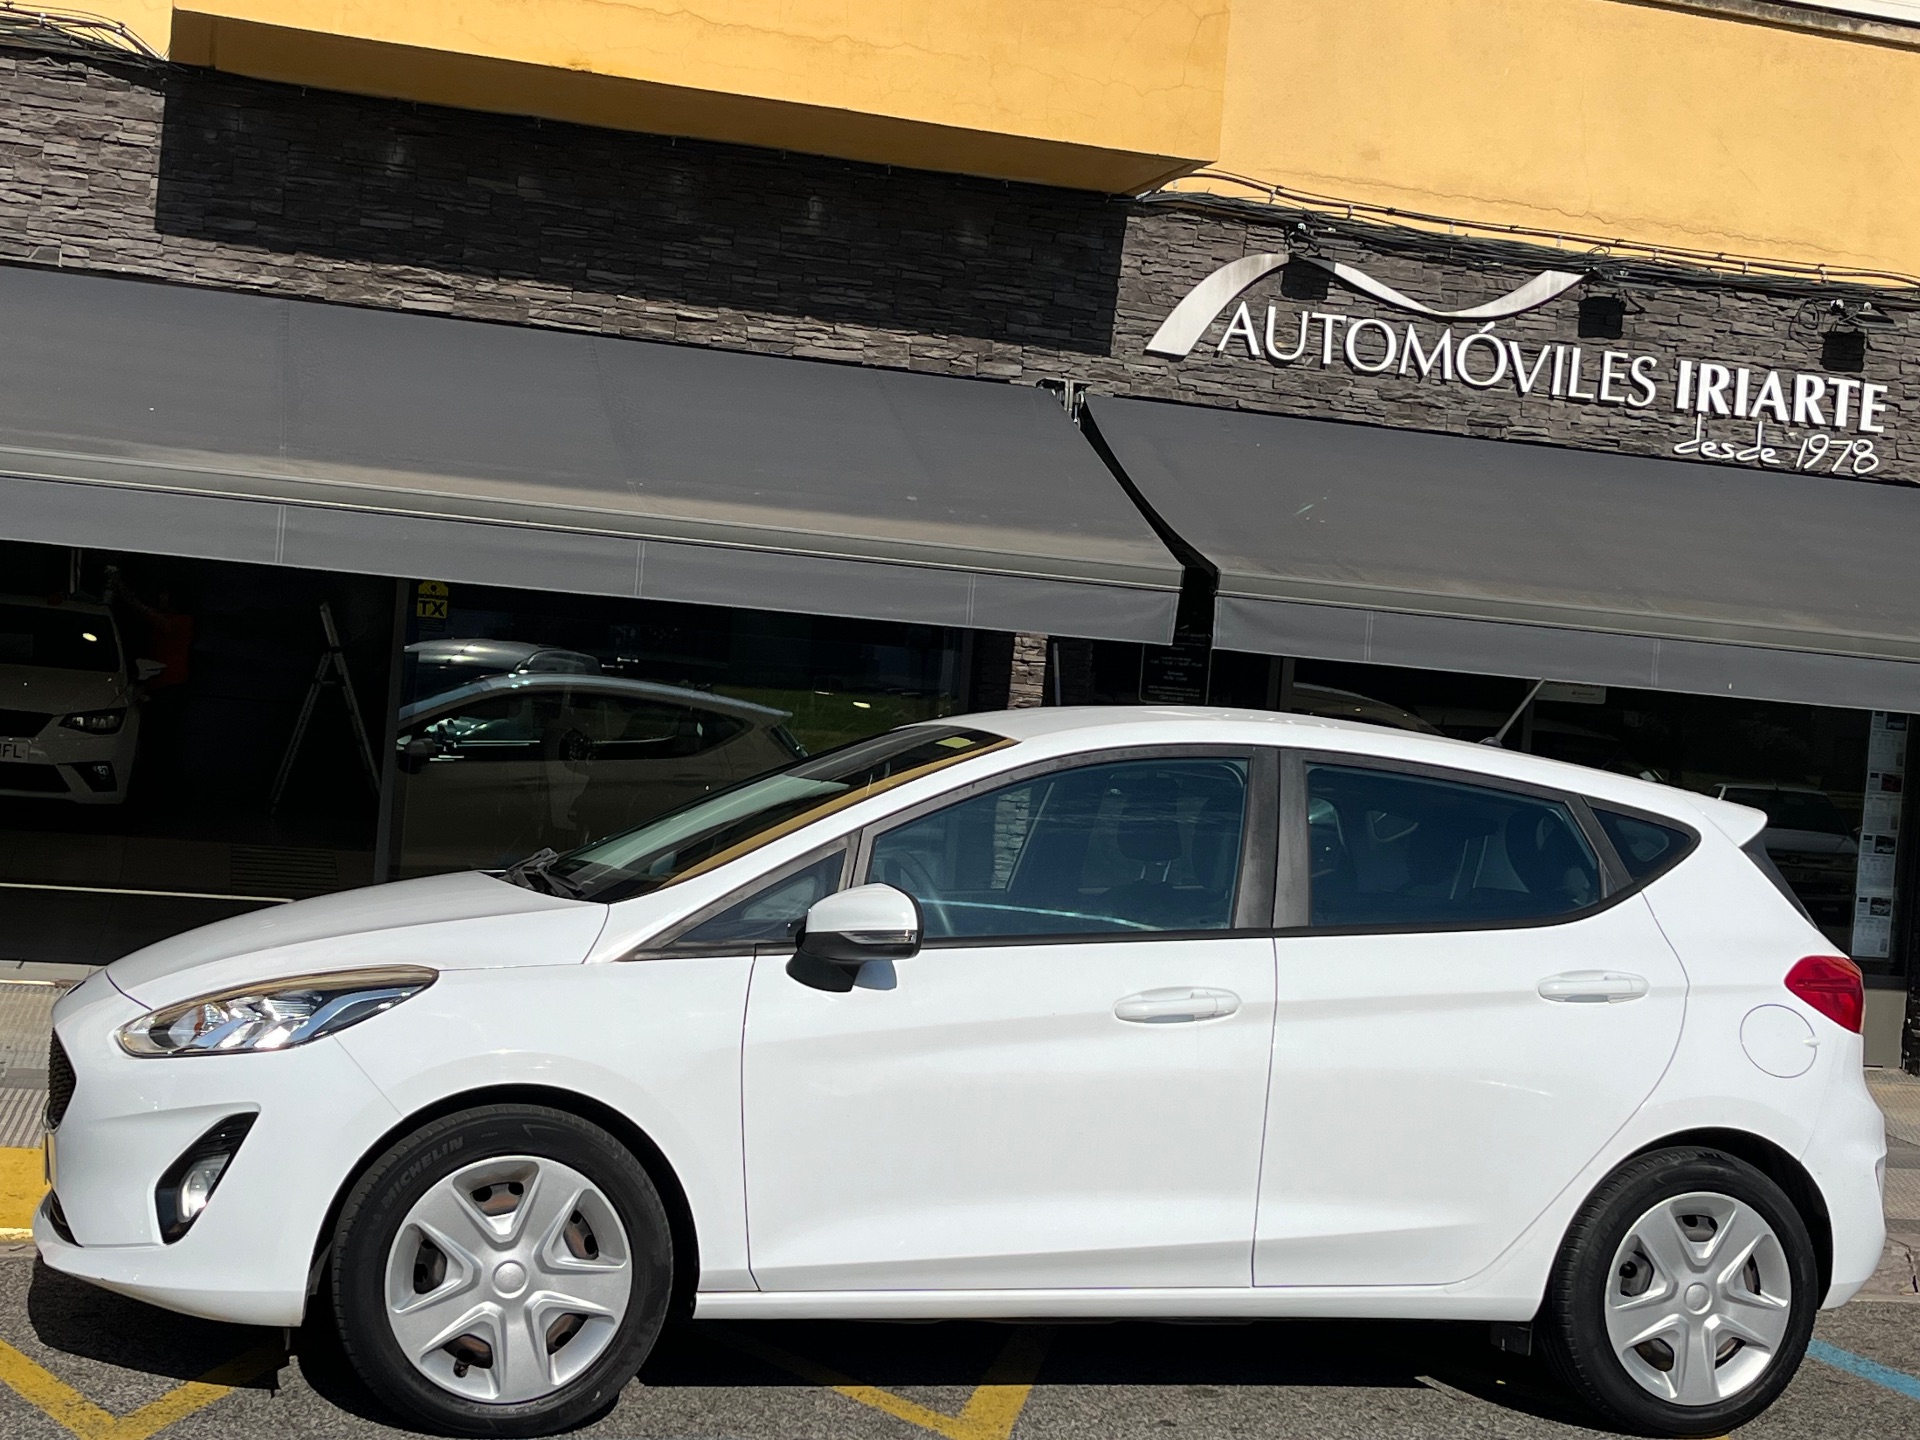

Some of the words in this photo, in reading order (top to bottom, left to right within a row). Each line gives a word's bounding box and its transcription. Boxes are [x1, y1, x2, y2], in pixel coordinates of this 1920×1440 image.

[1217, 301, 1657, 408] AUTOMÓVILES
[1676, 359, 1888, 434] IRIARTE
[1674, 413, 1780, 465] desde
[1796, 434, 1879, 474] 1978
[418, 600, 446, 617] TX
[0, 743, 22, 759] FL
[382, 1136, 464, 1209] MICHELIN
